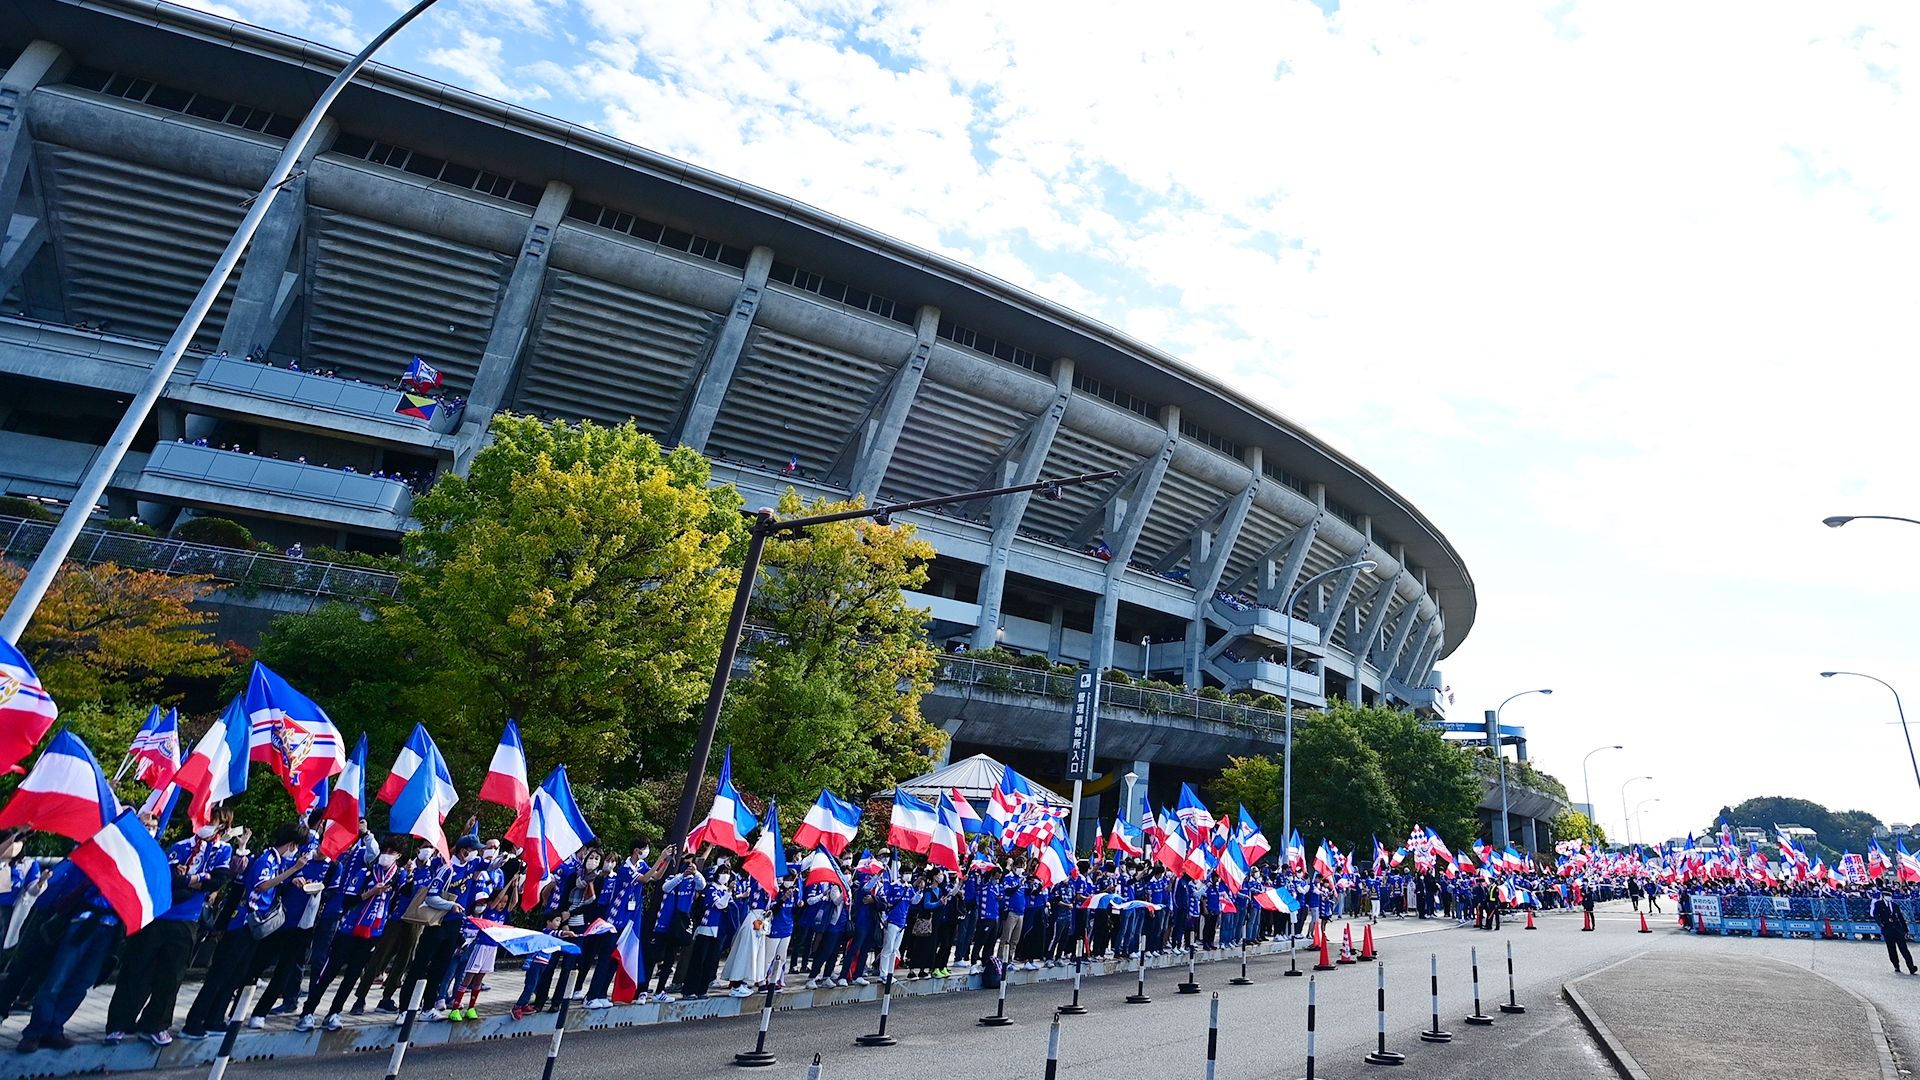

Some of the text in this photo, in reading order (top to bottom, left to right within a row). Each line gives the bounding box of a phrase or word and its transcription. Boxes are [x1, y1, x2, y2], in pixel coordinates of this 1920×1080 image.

[1070, 692, 1086, 773] 管理事務所入口
[1844, 855, 1857, 883] 横浜に
